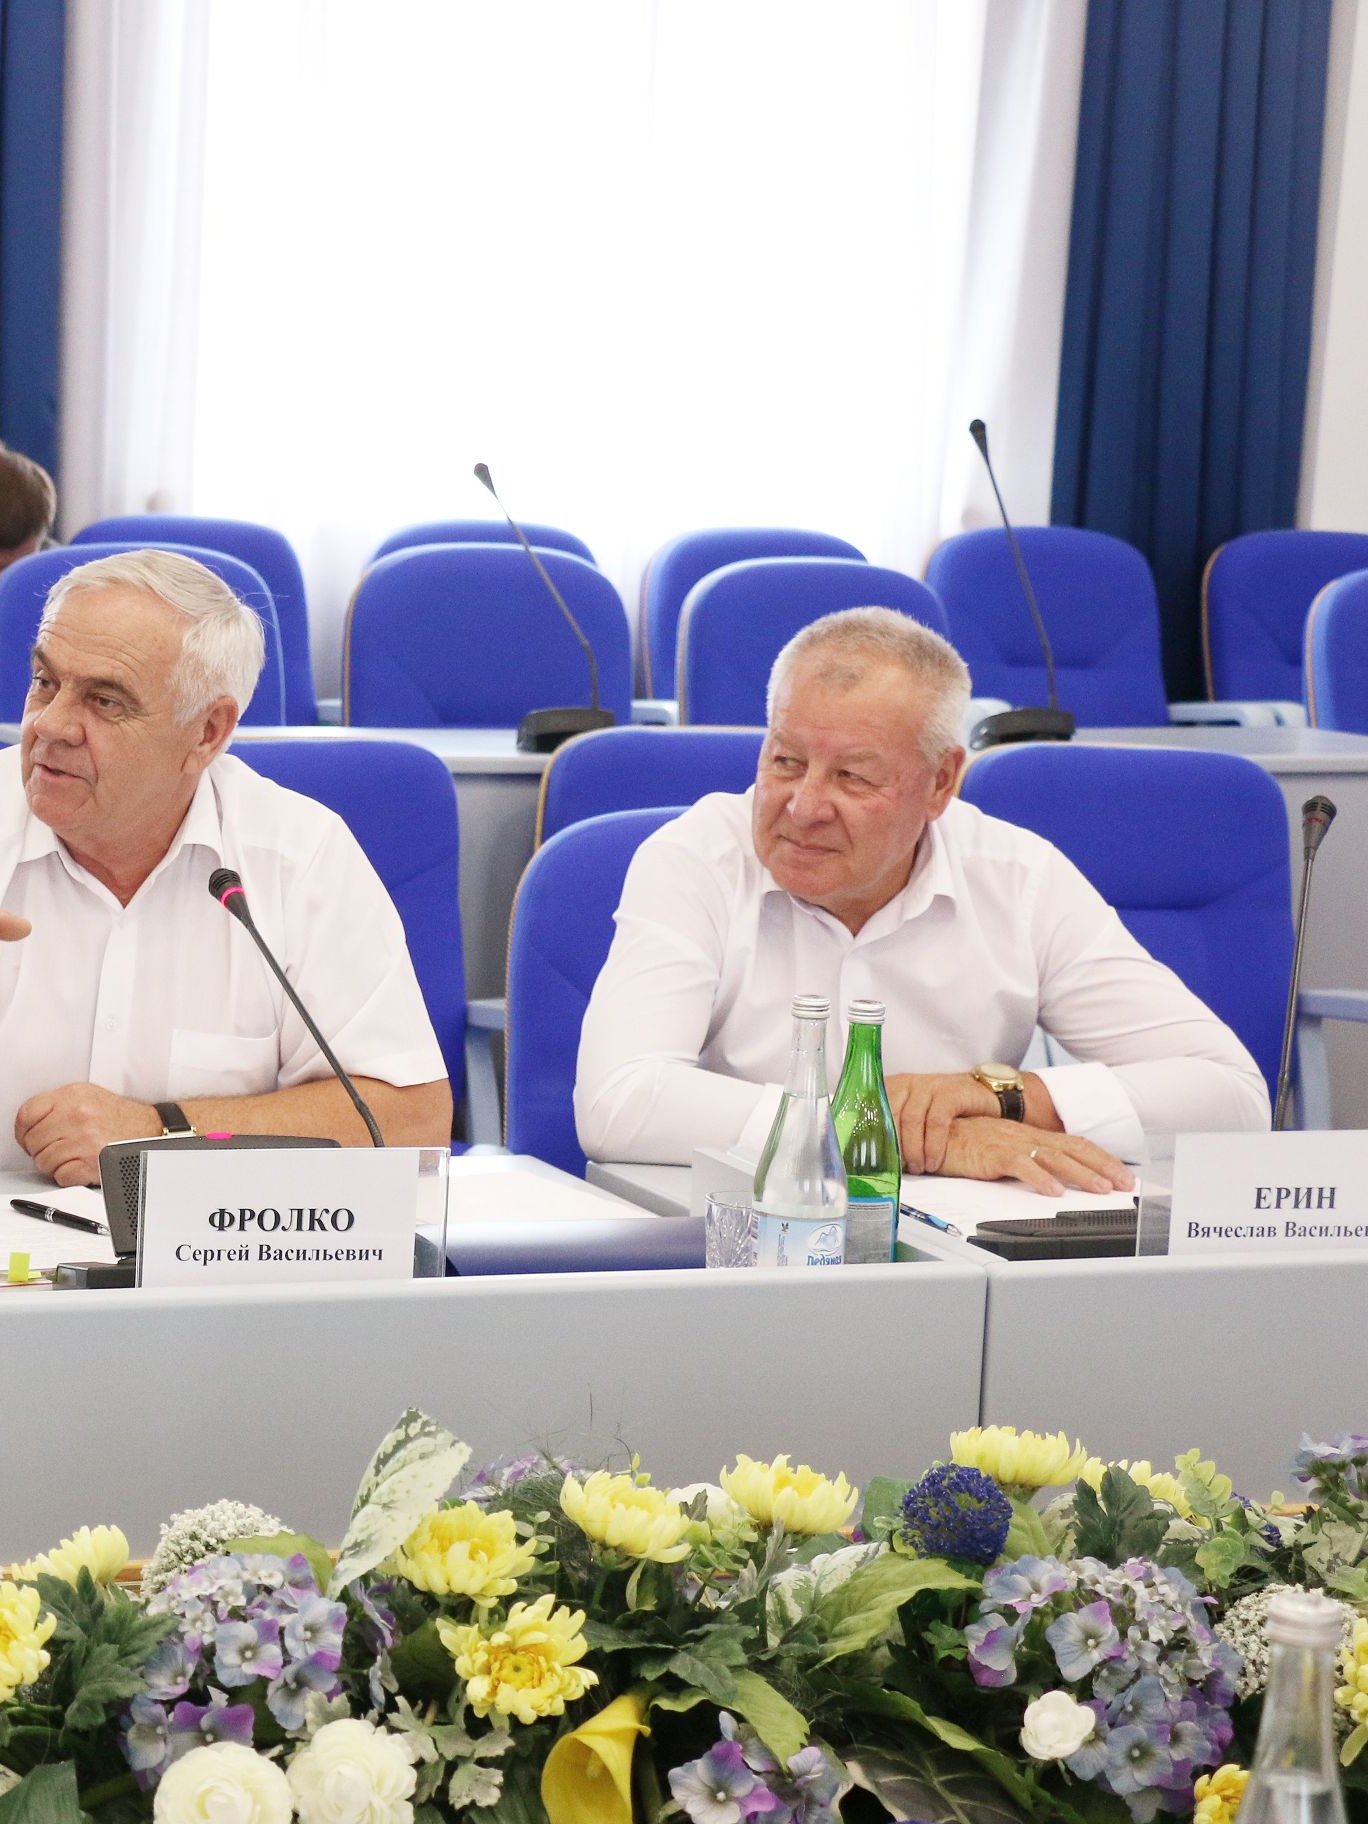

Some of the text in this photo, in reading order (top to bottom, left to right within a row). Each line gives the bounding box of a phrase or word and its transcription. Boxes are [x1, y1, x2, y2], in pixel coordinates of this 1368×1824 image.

[1253, 1186, 1338, 1210] ЕРИН
[208, 1207, 355, 1232] ФРОЛКО
[1187, 1221, 1277, 1238] Вячеслав
[175, 1243, 384, 1266] Сергей Васильевич
